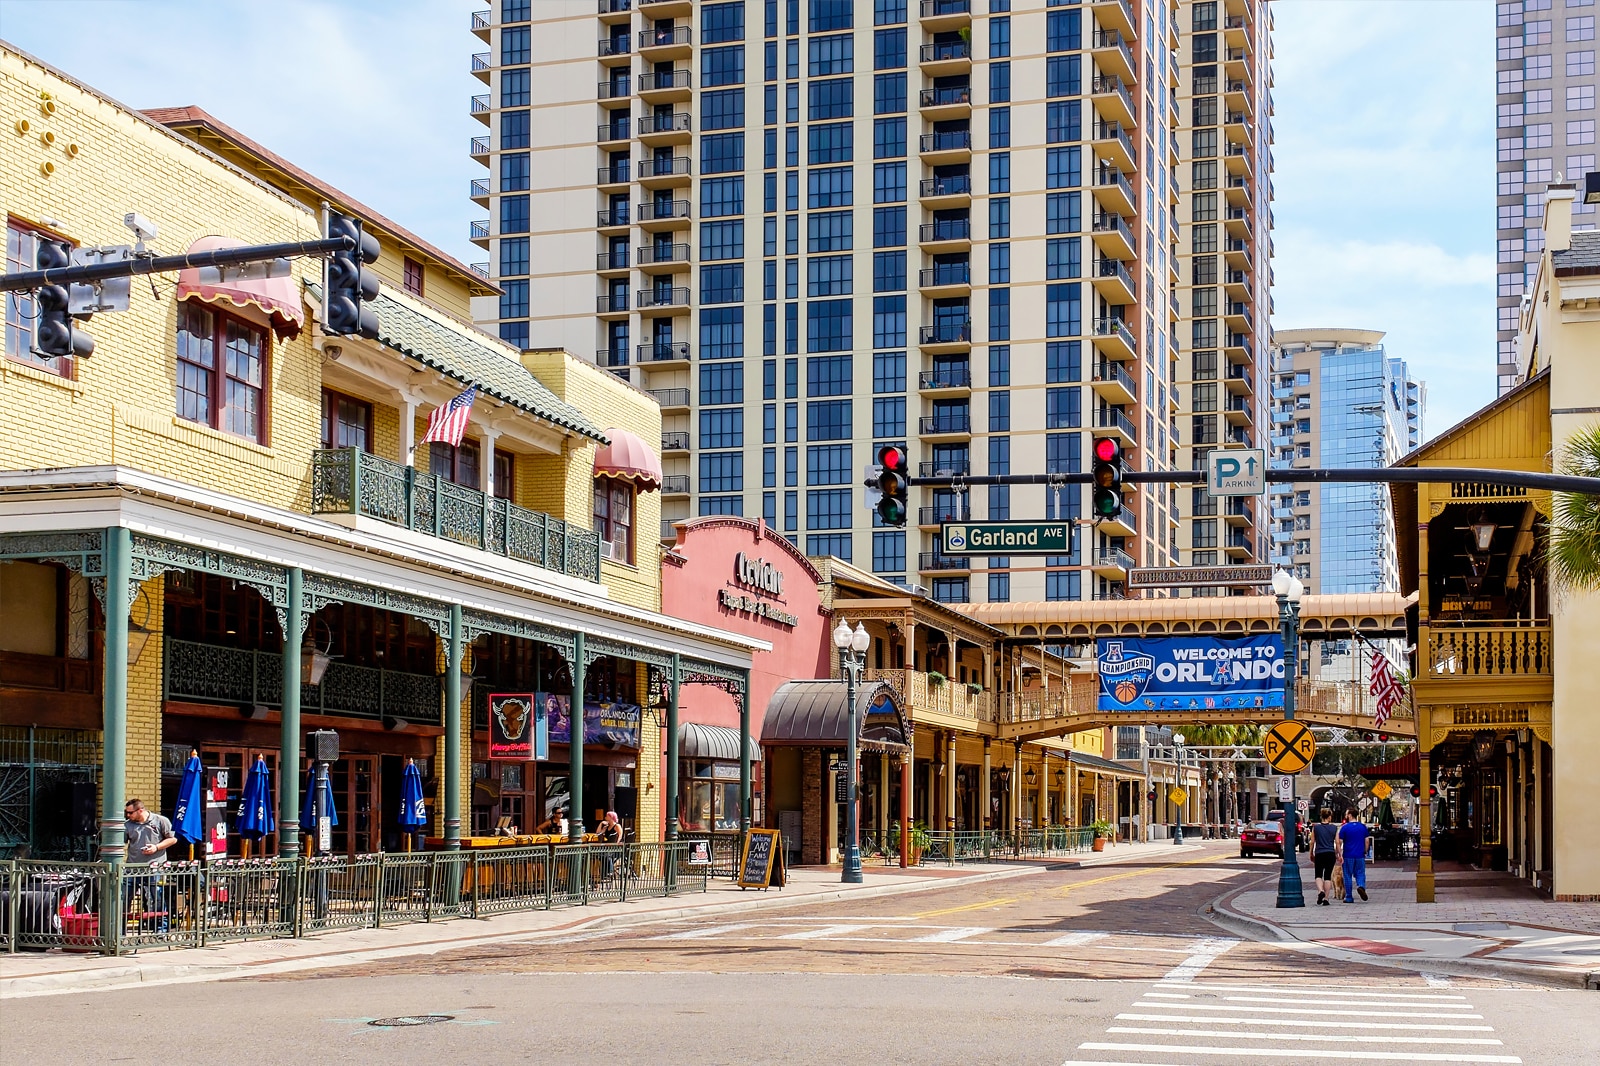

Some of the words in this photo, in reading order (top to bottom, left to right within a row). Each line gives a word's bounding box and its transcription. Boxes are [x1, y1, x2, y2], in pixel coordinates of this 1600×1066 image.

[970, 527, 1038, 546] Garland
[1043, 527, 1063, 538] AVE
[739, 552, 784, 595] Ceviche
[1135, 571, 1177, 583] CHURCH
[1179, 570, 1219, 582] STREET
[1223, 568, 1268, 580] STATION
[722, 589, 744, 610] Tapas
[745, 596, 758, 613] Bar
[766, 603, 798, 627] Restaurant
[1173, 648, 1252, 660] WELCOME
[1255, 646, 1276, 658] TO
[1102, 658, 1150, 673] CHAMPIONSHIP
[1156, 659, 1285, 685] ORLANDO
[600, 709, 626, 720] ORLANDO
[1268, 742, 1278, 754] R
[1301, 740, 1311, 752] R
[754, 842, 769, 852] AAC
